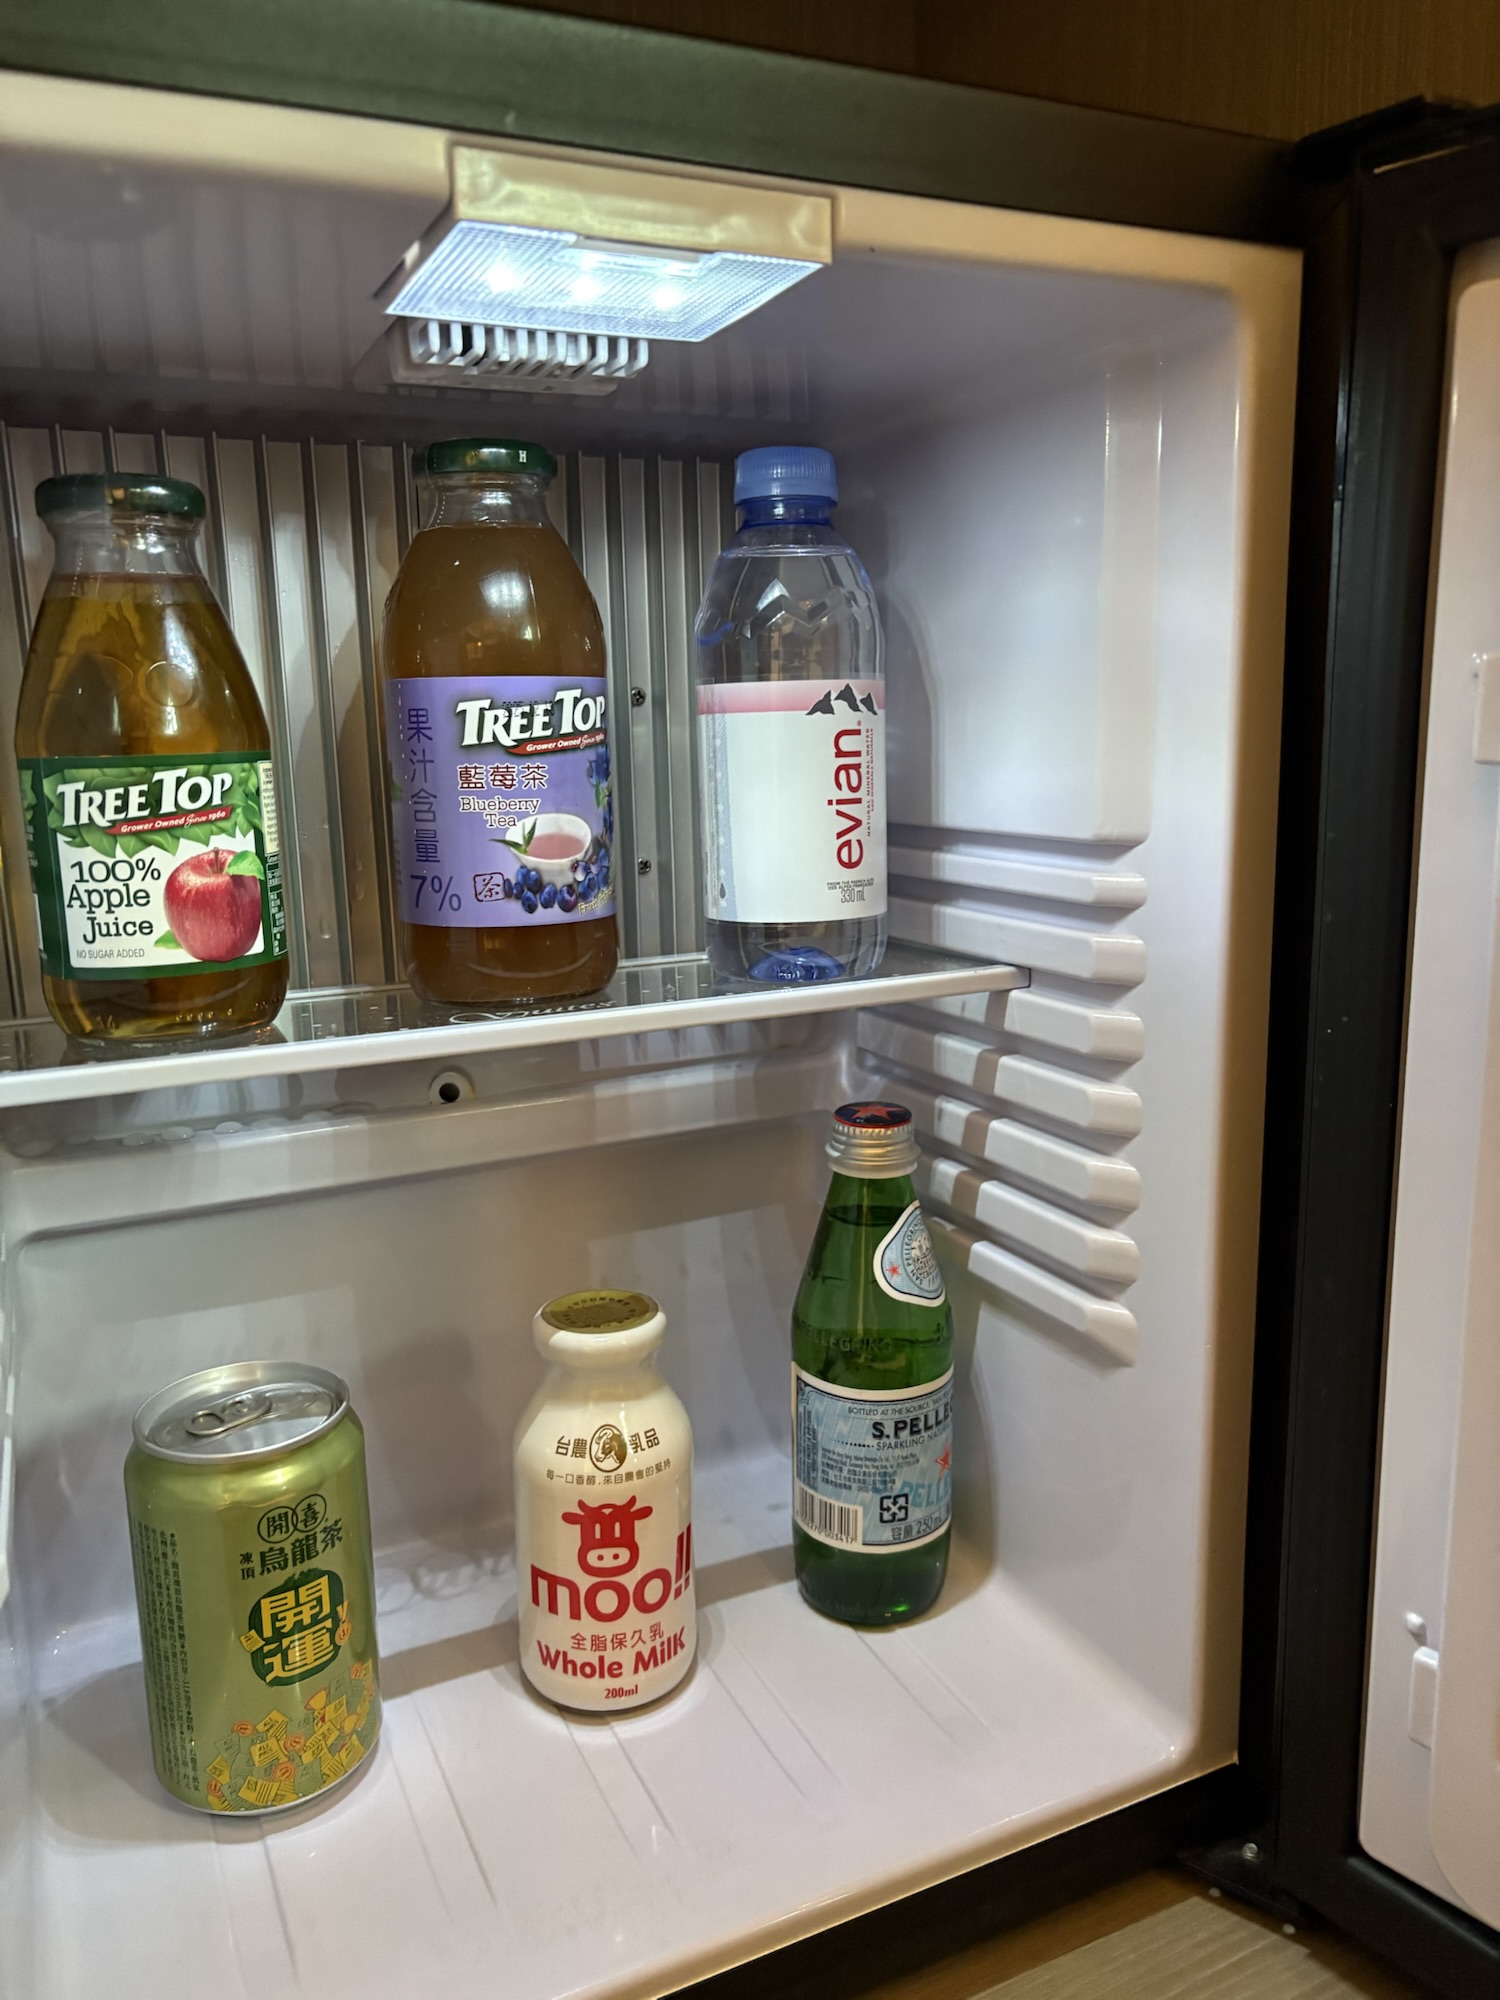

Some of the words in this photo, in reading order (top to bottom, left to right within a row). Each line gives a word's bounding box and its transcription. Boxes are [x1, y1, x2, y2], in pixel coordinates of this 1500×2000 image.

[455, 699, 555, 747] TREE
[554, 688, 606, 735] TOP
[526, 742, 556, 752] Grower
[557, 738, 581, 748] Owned
[407, 708, 440, 863] 果汁含量
[458, 763, 547, 789] 藍莓茶
[56, 780, 151, 828] TREE
[153, 768, 232, 813] TOP
[460, 797, 539, 812] Blueberry
[827, 728, 864, 869] evian
[121, 823, 152, 833] Grower
[155, 817, 184, 828] Owned
[184, 814, 207, 828] Since
[209, 810, 226, 821] 1960
[485, 813, 517, 827] Tea
[71, 857, 161, 883] 100%
[67, 883, 150, 914] Apple
[410, 875, 461, 912] 7%
[841, 888, 855, 903] 330
[83, 917, 153, 944] Juice
[77, 949, 87, 959] NO
[88, 949, 114, 959] SUGAR
[117, 948, 145, 958] ADDED
[848, 1406, 878, 1416] BOTTLED
[555, 1435, 587, 1459] 台農
[629, 1427, 660, 1454] 乳品
[876, 1435, 924, 1451] SPARKLING
[266, 1502, 320, 1538] 開喜
[259, 1518, 343, 1576] 烏龍茶
[240, 1552, 255, 1580] 凍頂
[261, 1574, 335, 1684] 開運
[571, 1621, 664, 1652] 全脂保久乳
[537, 1639, 623, 1679] Whole
[604, 1683, 638, 1699] 200ml
